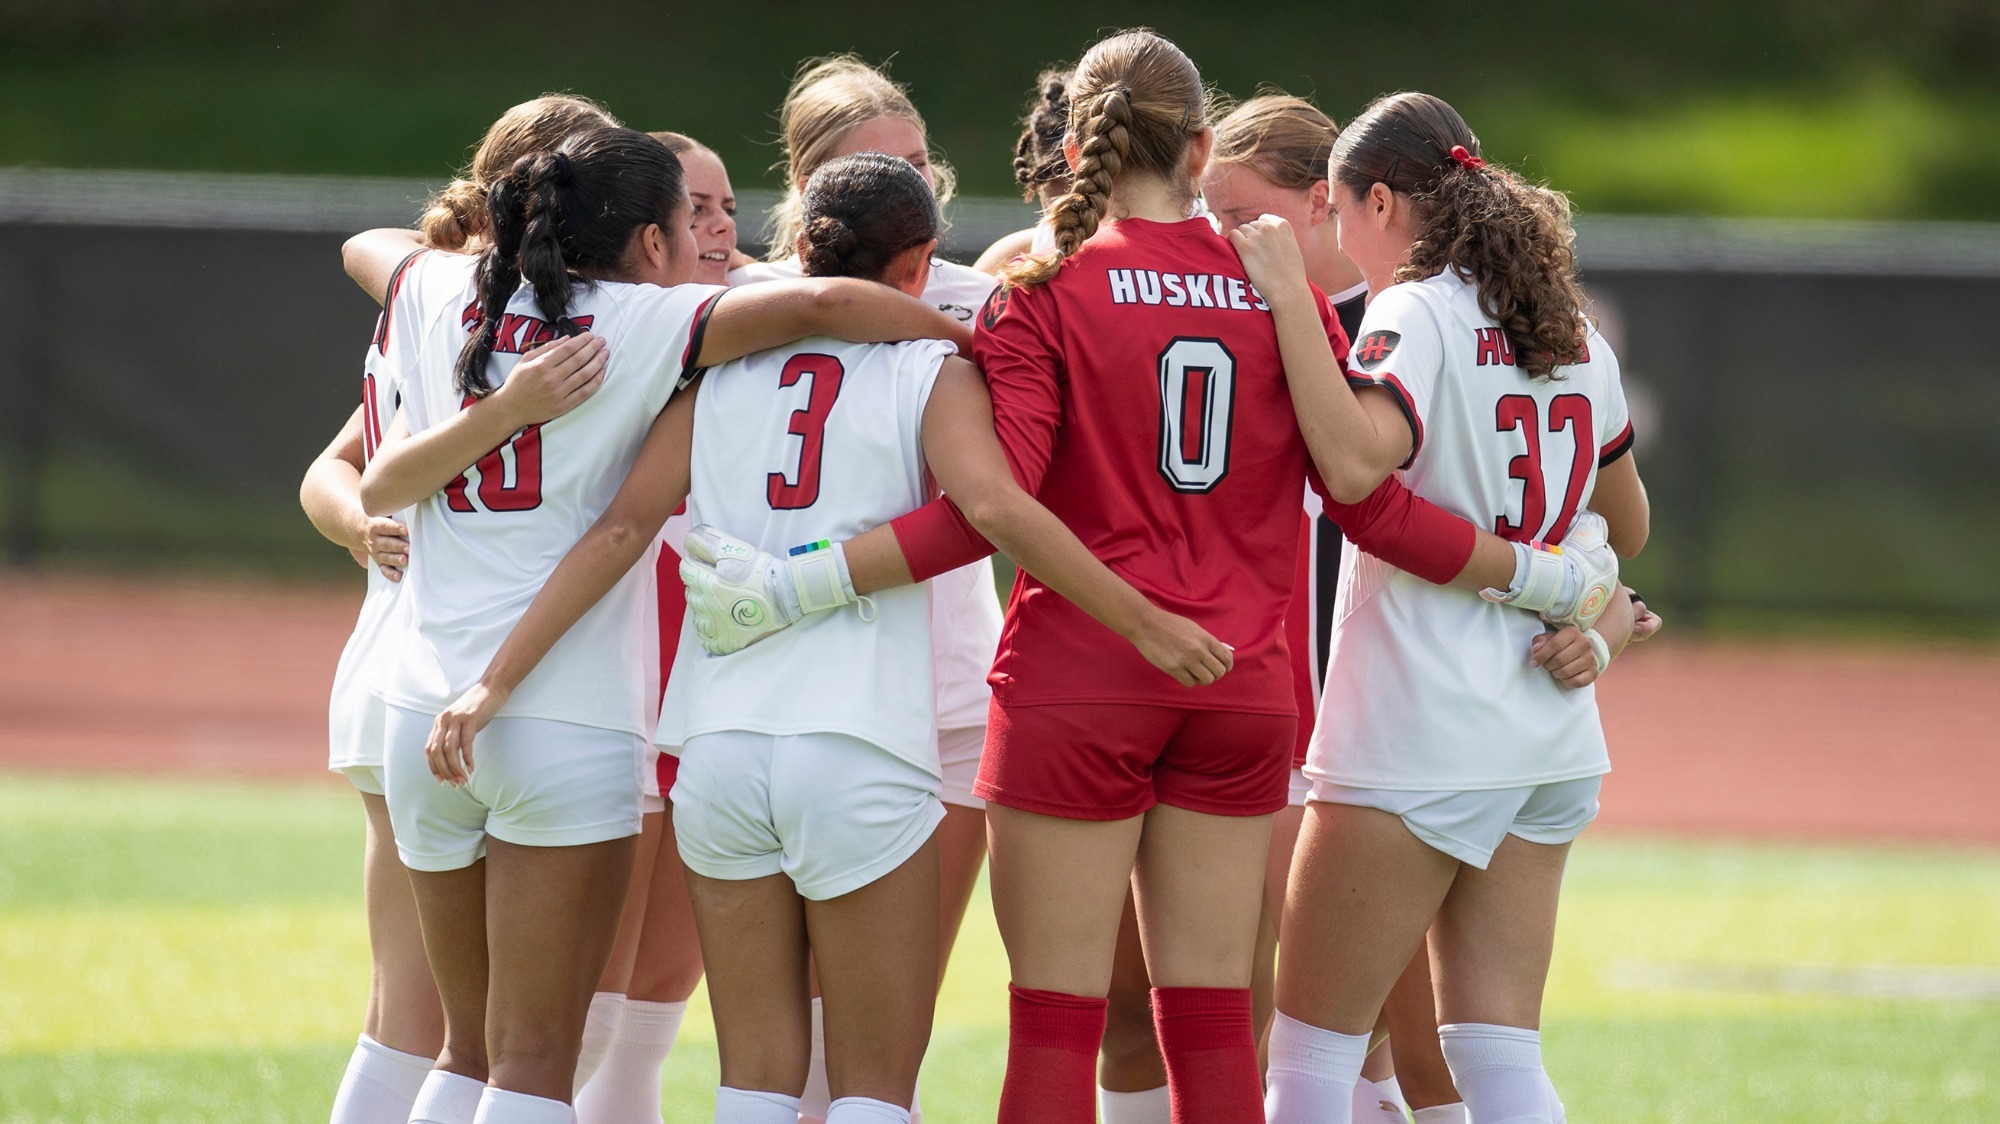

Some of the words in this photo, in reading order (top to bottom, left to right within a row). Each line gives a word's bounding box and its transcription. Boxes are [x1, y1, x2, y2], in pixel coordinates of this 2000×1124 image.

[1156, 335, 1237, 495] 0
[1357, 335, 1393, 362] H
[766, 353, 845, 510] 3
